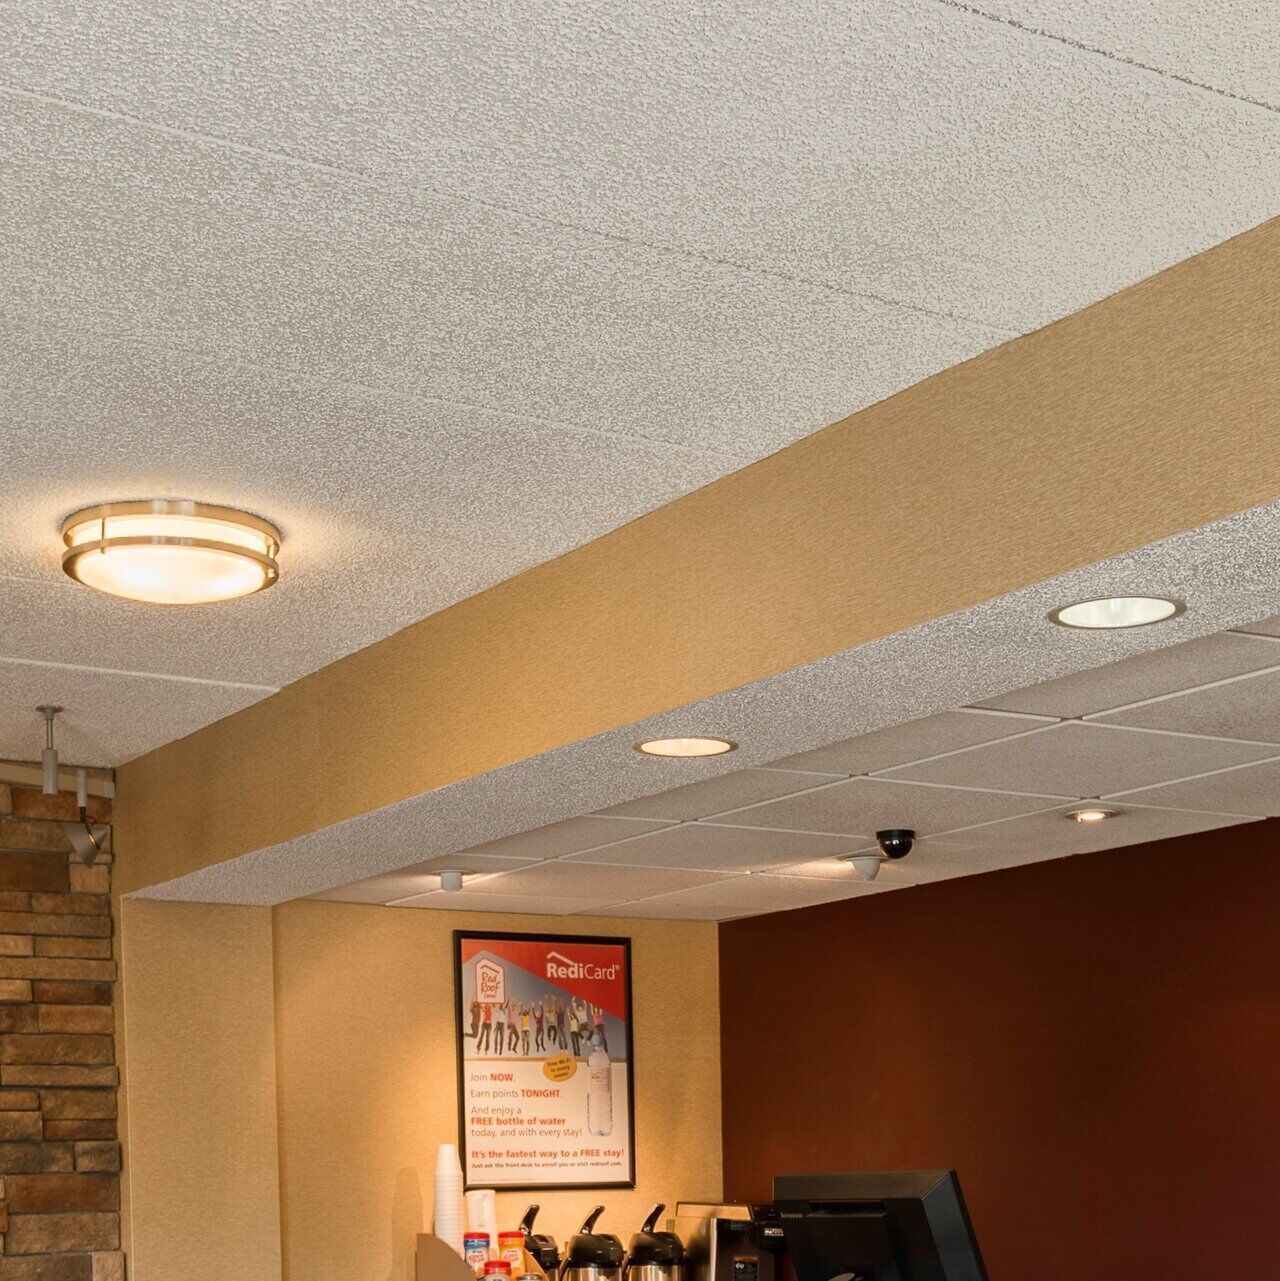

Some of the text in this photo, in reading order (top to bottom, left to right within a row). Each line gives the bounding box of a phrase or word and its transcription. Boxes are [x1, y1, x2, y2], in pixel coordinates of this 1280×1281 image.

[481, 971, 497, 982] Red
[481, 981, 501, 993] Roof
[470, 1073, 488, 1082] Join
[470, 1089, 490, 1098] Earn
[492, 1090, 519, 1099] points
[471, 1106, 489, 1114] And
[491, 1106, 514, 1116] enjoy
[471, 1117, 494, 1126] FREE
[496, 1116, 525, 1126] bottle
[527, 1116, 537, 1125] of
[471, 1128, 582, 1139] today, and with every stay!
[471, 1150, 486, 1159] It's
[488, 1150, 503, 1158] the
[506, 1149, 537, 1158] fastest
[539, 1150, 558, 1159] way
[560, 1150, 570, 1158] to
[580, 1148, 601, 1157] FREE
[603, 1148, 625, 1159] stay!
